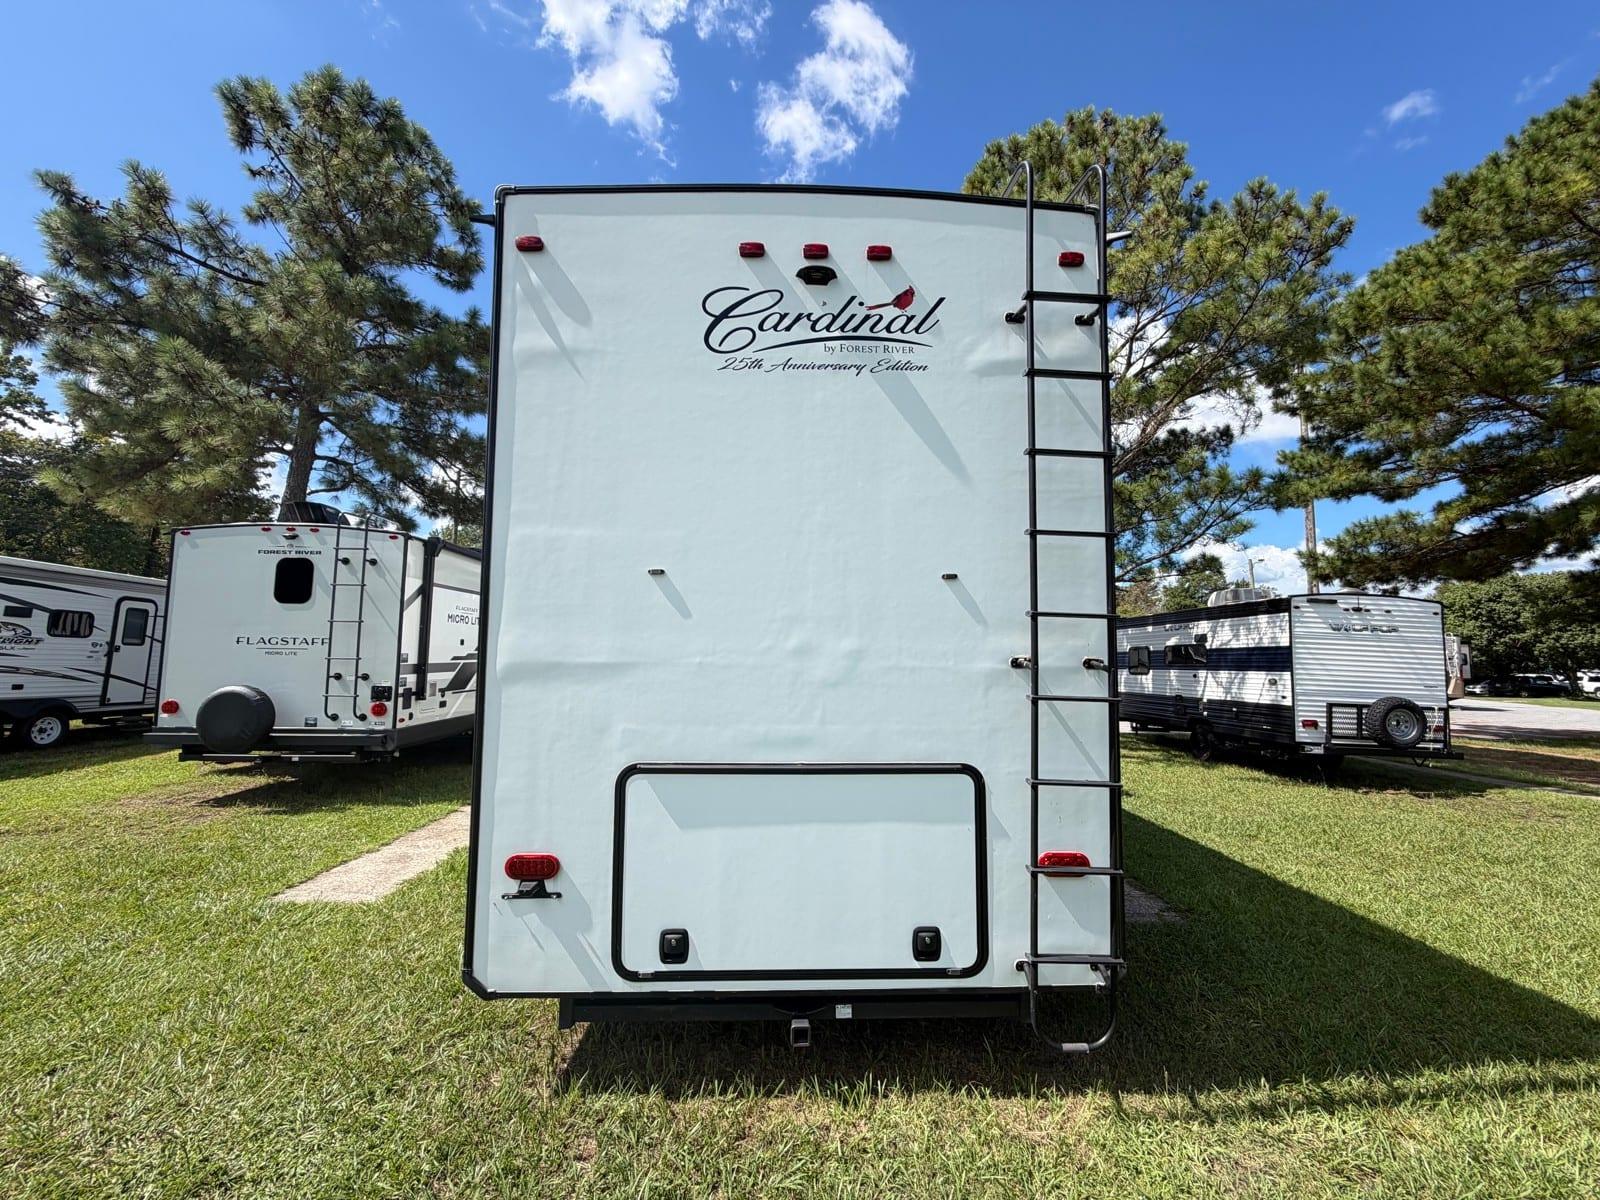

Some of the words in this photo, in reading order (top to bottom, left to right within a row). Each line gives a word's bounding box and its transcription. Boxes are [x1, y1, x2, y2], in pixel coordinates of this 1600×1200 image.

[701, 286, 946, 354] Cardinal
[824, 342, 837, 355] by
[840, 343, 879, 353] FOREST
[883, 344, 915, 354] RIVER
[717, 356, 763, 371] 25th
[765, 357, 867, 376] Anniversary
[870, 358, 929, 374] Edition
[447, 613, 470, 625] MICRO
[235, 636, 330, 646] FLAGSTAFF
